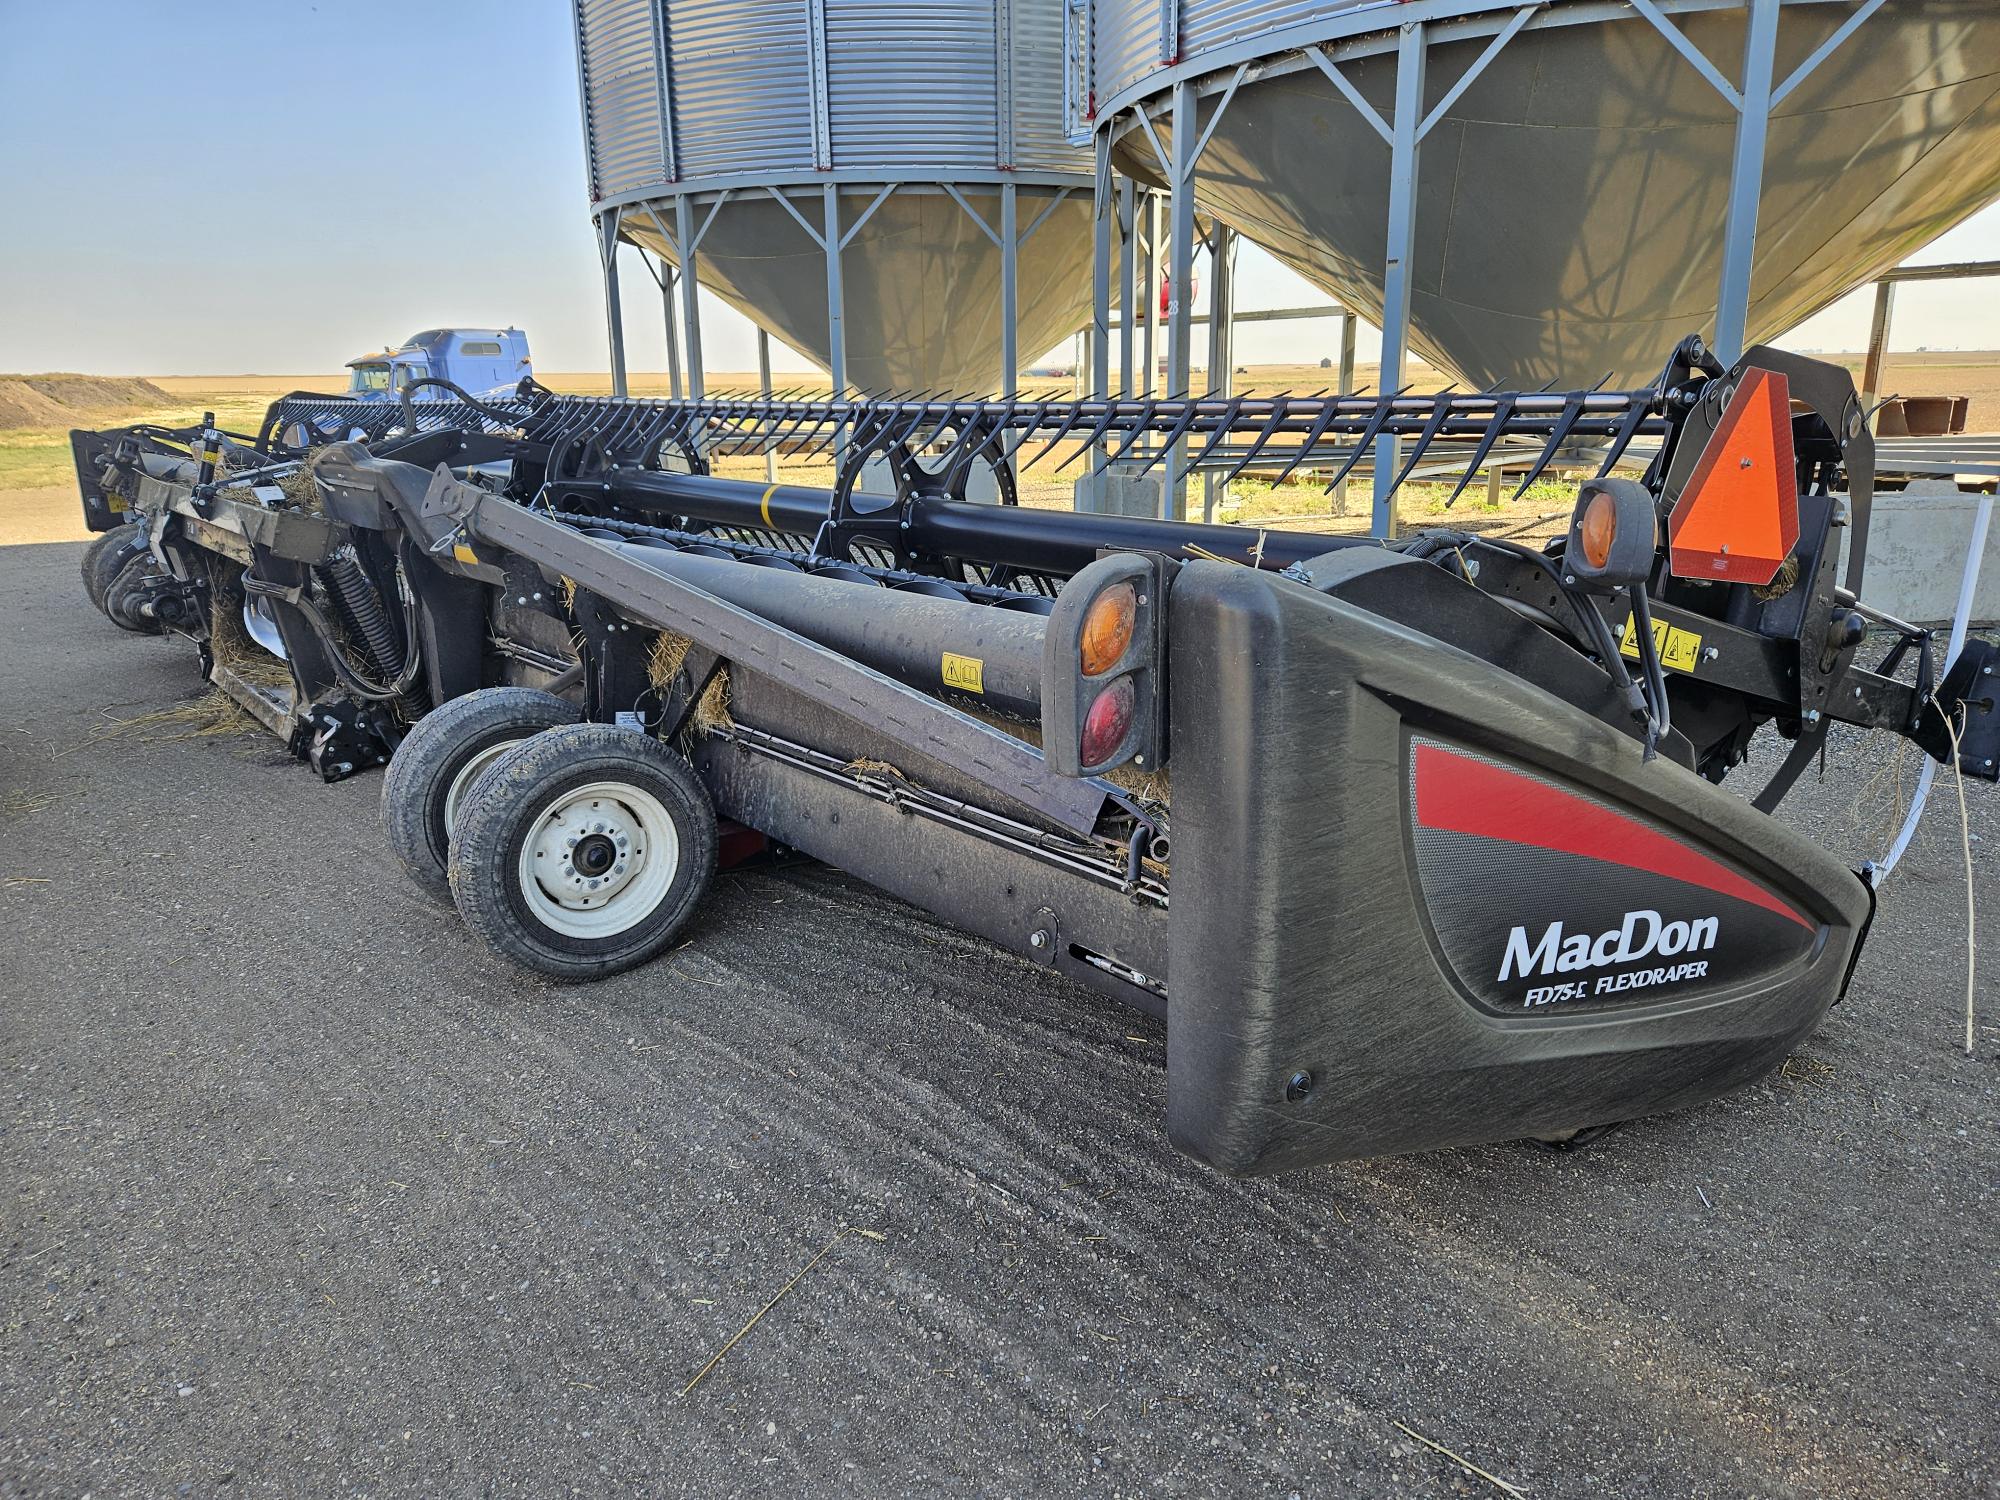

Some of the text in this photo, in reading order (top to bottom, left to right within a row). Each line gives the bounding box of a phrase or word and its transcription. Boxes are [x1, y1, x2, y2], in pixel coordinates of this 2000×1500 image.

[1168, 300, 1179, 315] 28
[1497, 909, 1719, 982] MacDon
[1594, 960, 1709, 995] FLEXDRAPER
